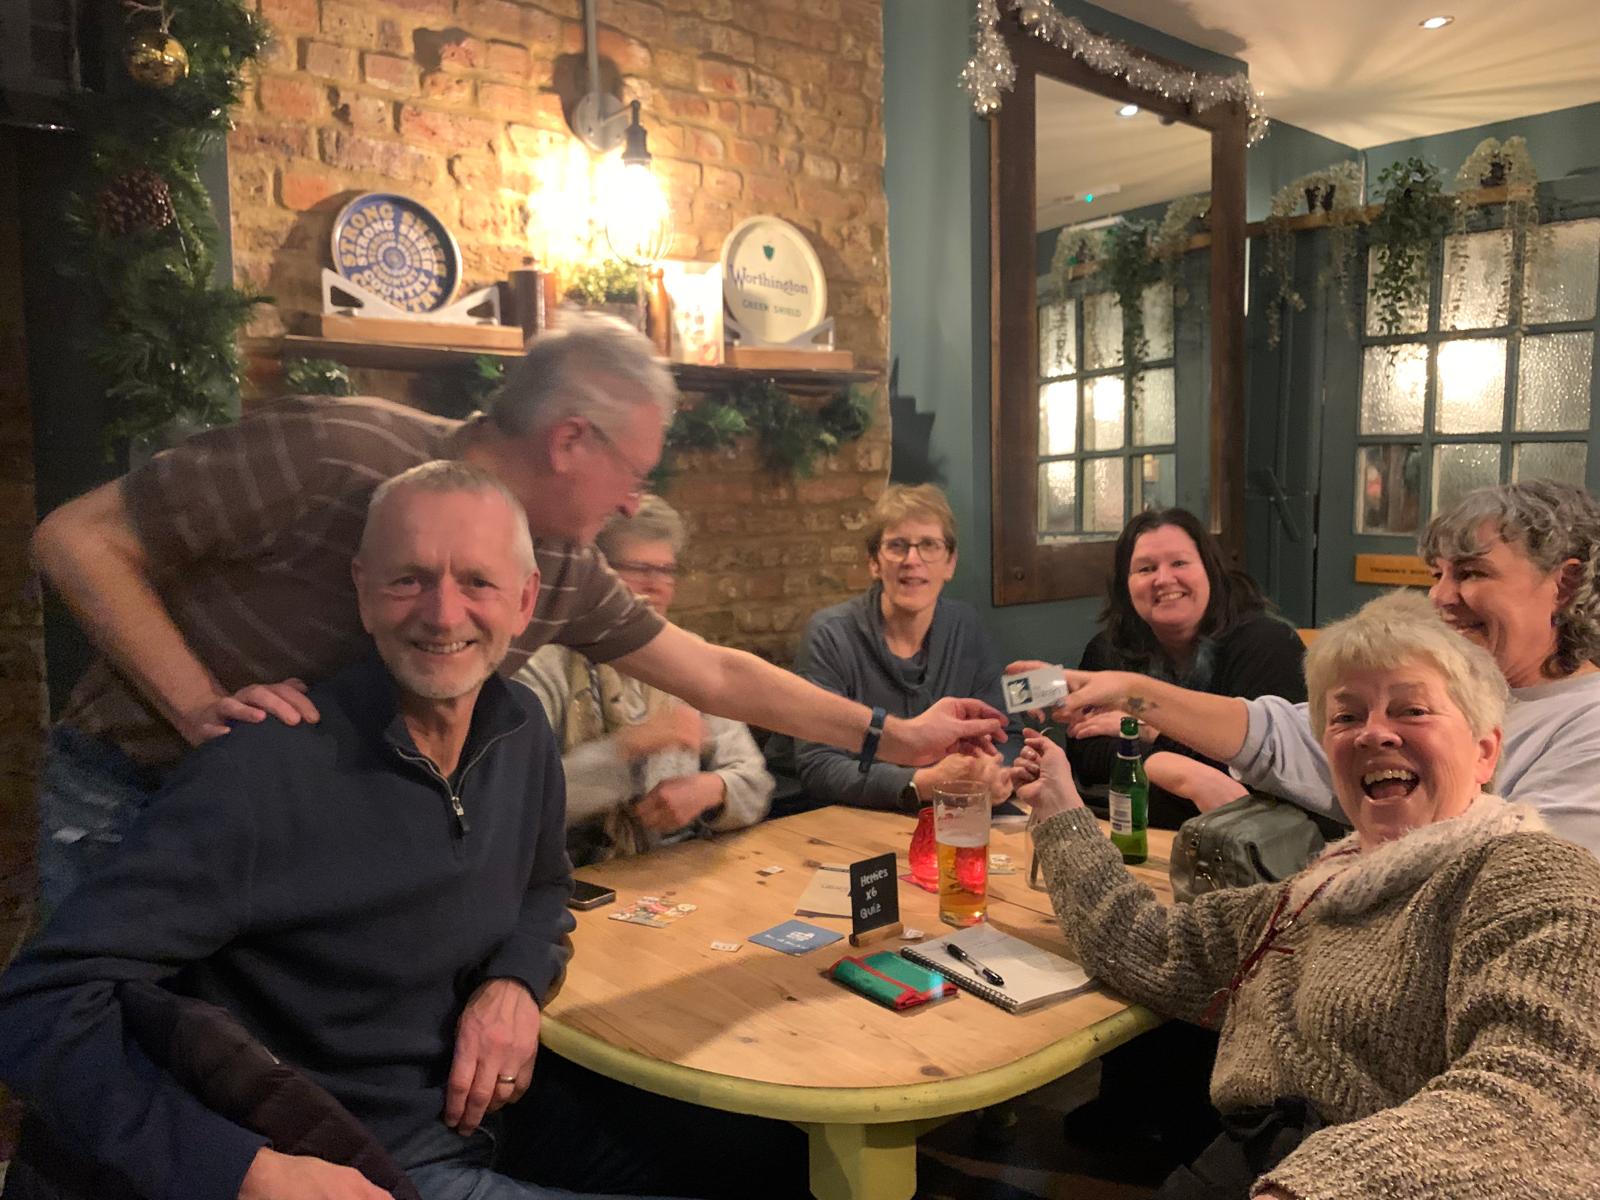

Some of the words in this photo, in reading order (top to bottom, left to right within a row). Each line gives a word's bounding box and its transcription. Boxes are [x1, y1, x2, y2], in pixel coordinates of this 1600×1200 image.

[340, 202, 395, 268] STRONG
[728, 263, 809, 296] Worthington
[743, 299, 769, 312] GREEN
